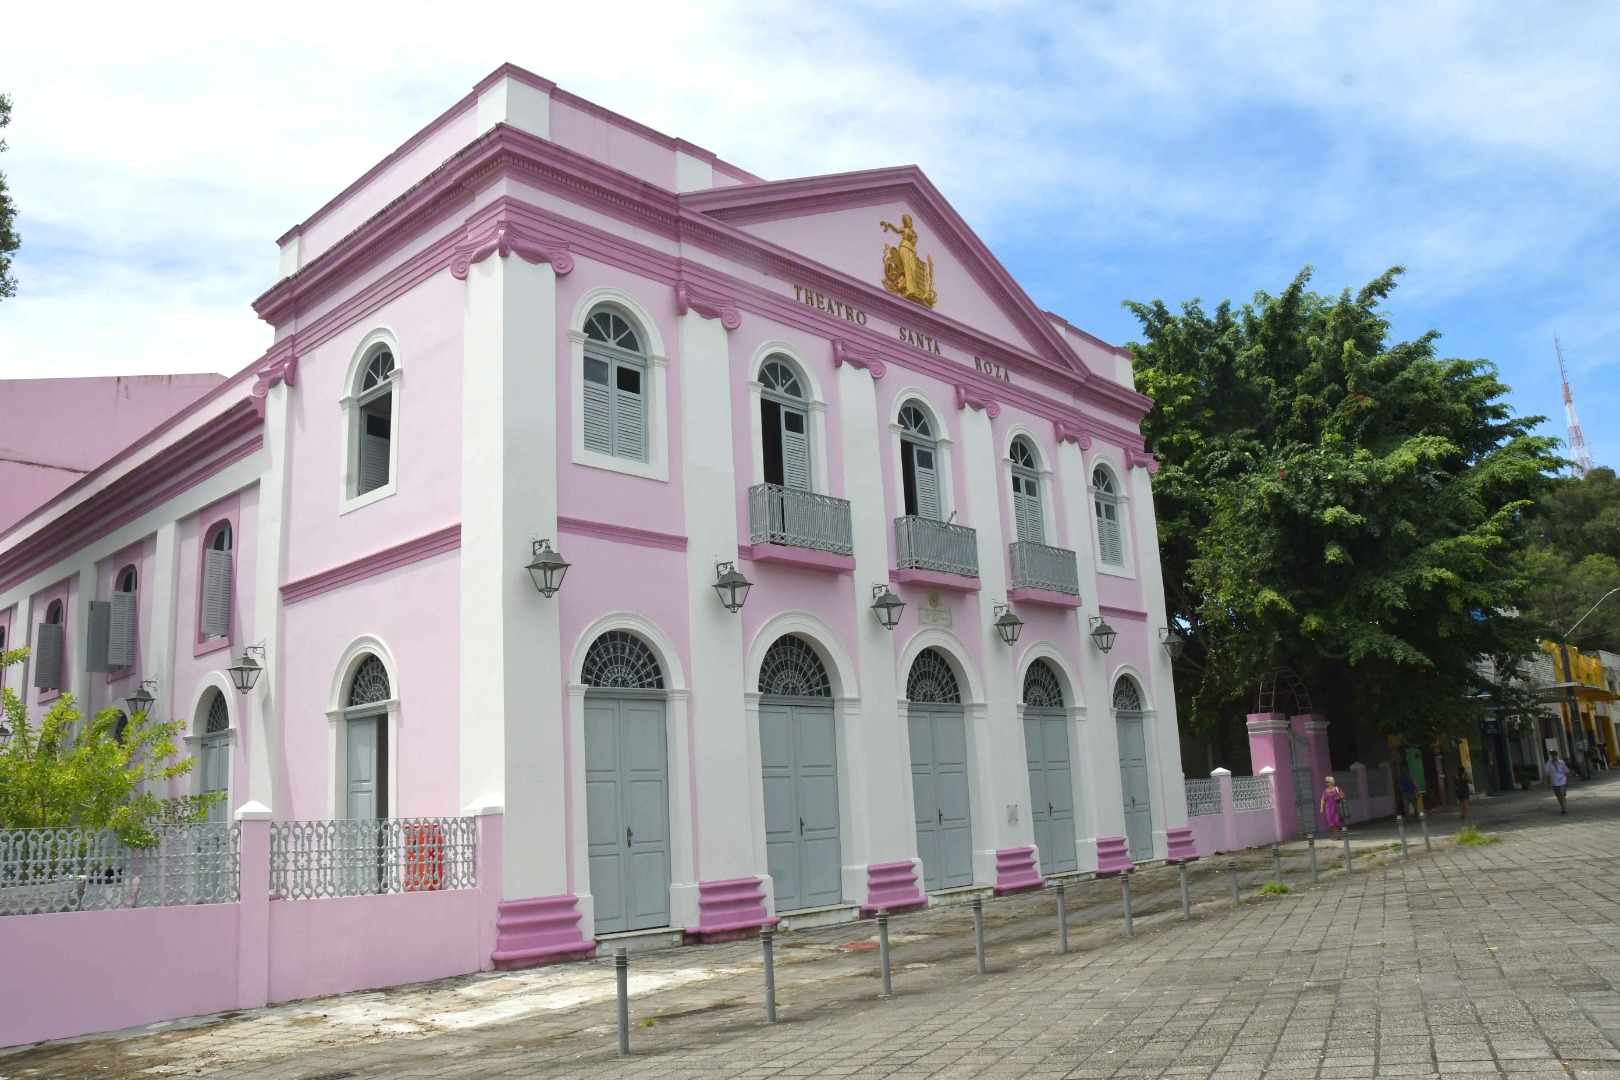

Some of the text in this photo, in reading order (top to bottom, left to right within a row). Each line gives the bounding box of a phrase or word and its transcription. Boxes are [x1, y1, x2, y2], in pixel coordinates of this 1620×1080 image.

[793, 284, 1011, 382] THEATRO SANTA ROZA
